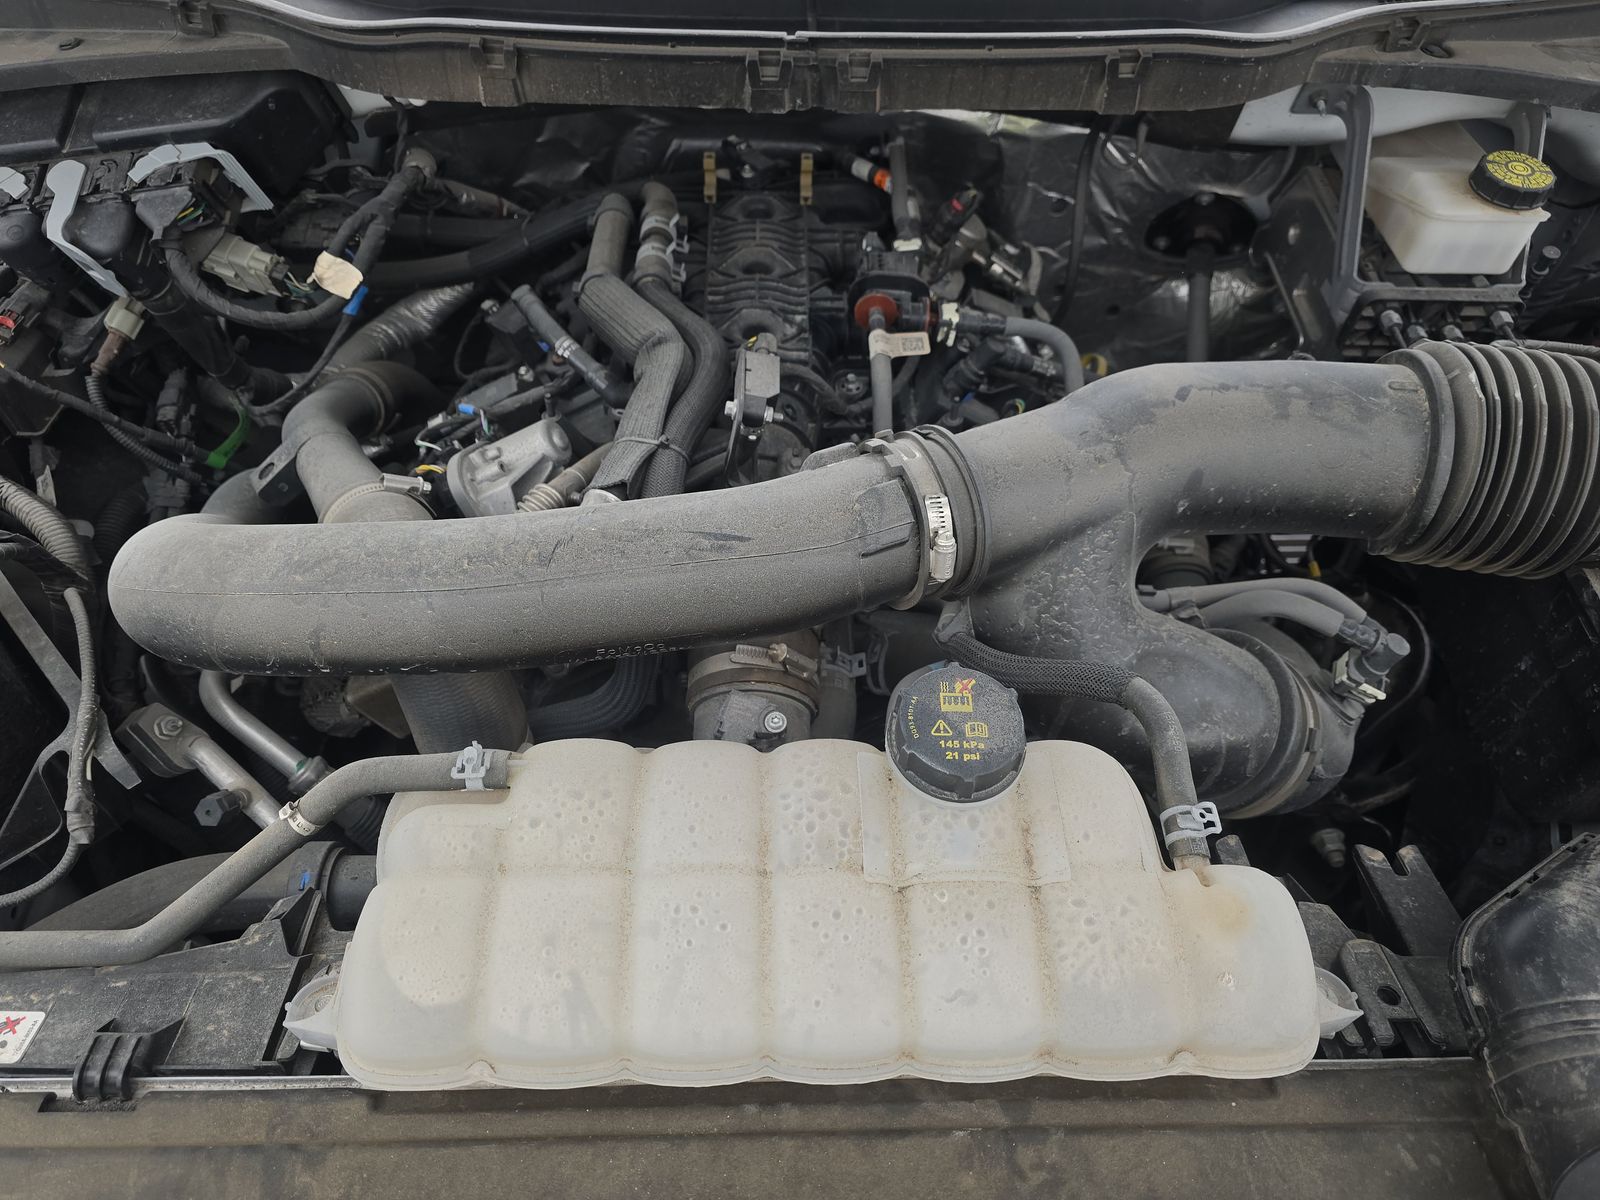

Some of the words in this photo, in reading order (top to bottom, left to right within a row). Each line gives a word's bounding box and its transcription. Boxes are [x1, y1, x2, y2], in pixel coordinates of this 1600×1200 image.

[939, 740, 960, 749] 145
[963, 740, 985, 749] kPa
[945, 751, 959, 761] 21
[963, 752, 980, 762] psi
